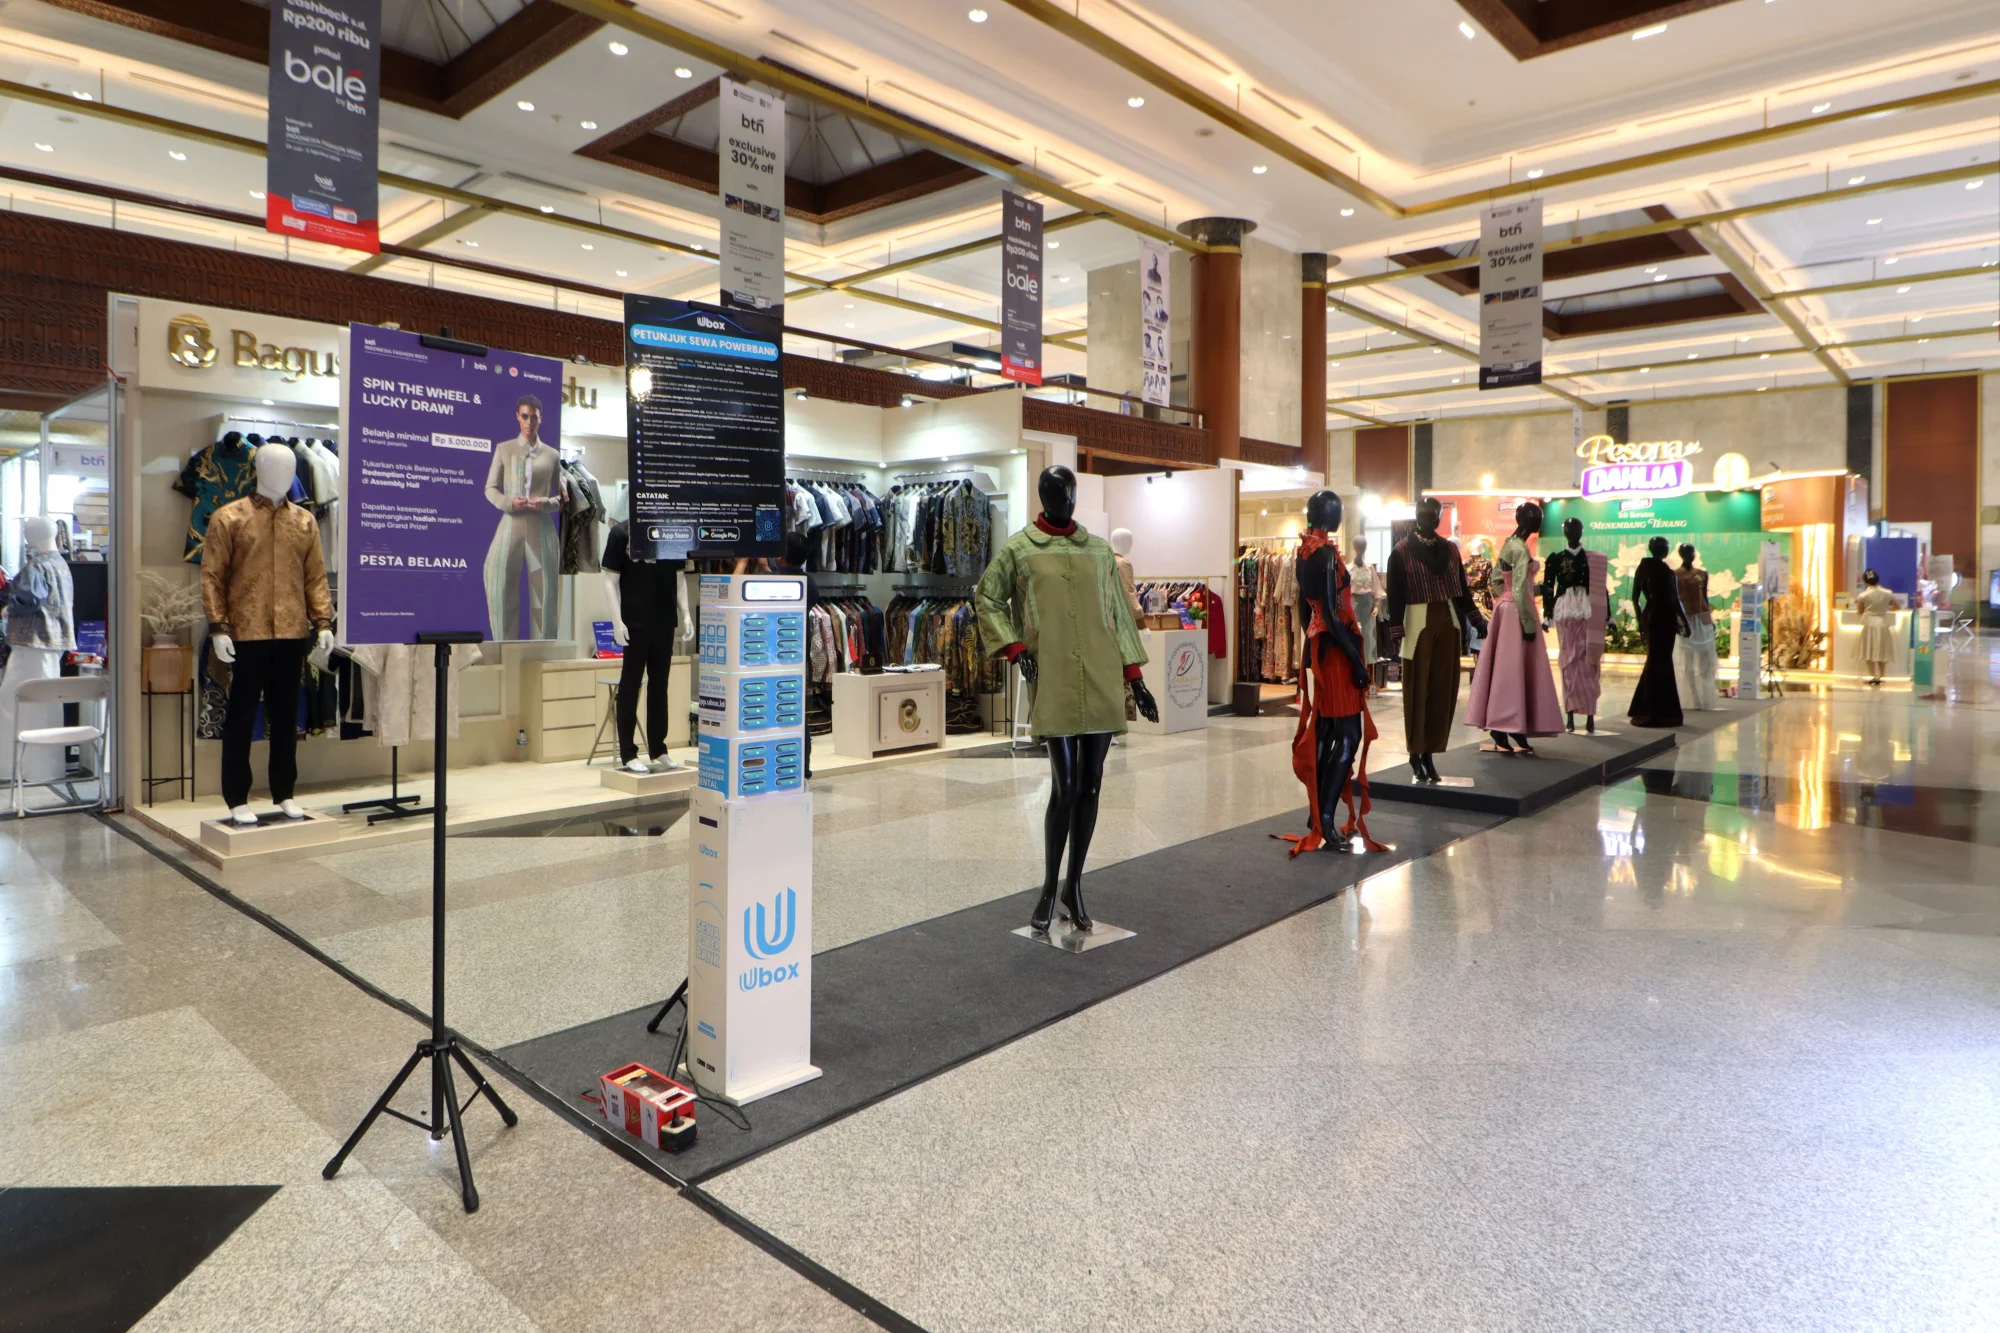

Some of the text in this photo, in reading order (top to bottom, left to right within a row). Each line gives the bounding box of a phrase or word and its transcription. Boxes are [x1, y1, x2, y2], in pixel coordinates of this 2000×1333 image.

[287, 0, 350, 22] cashback
[283, 8, 370, 49] Rp200 ribu
[314, 44, 340, 61] pakai
[729, 138, 776, 160] exclusive
[732, 150, 774, 175] 30% off
[1006, 244, 1039, 261] Rp200 ribu
[1488, 242, 1534, 256] exclusive
[1491, 253, 1532, 268] 30% off
[697, 317, 725, 330] Ubox
[634, 329, 776, 356] PETUNJUK SEWA POWERBANK
[231, 329, 339, 383] Bagu
[363, 377, 482, 404] SPIN THE WHEEL &
[363, 393, 454, 415] LUCKY DRAW!
[363, 428, 488, 448] Belanja minimal Rp 5.000.000
[1576, 434, 1686, 464] Pesona
[362, 460, 394, 469] Tukarkan
[414, 465, 438, 474] Belanja
[362, 469, 404, 478] Redemption
[432, 476, 448, 484] yang
[370, 479, 404, 488] Assembly
[1588, 464, 1678, 494] DAHLIA
[636, 492, 670, 500] CATATAN:
[361, 512, 412, 521] memenangkan
[362, 503, 437, 514] Dapatkan kesempatan
[361, 521, 385, 530] hingga
[360, 555, 467, 568] PESTA BELANJA
[699, 844, 718, 858] Ubox
[696, 919, 720, 940] SEWA
[696, 946, 720, 968] BANK
[740, 962, 799, 992] Ubox
